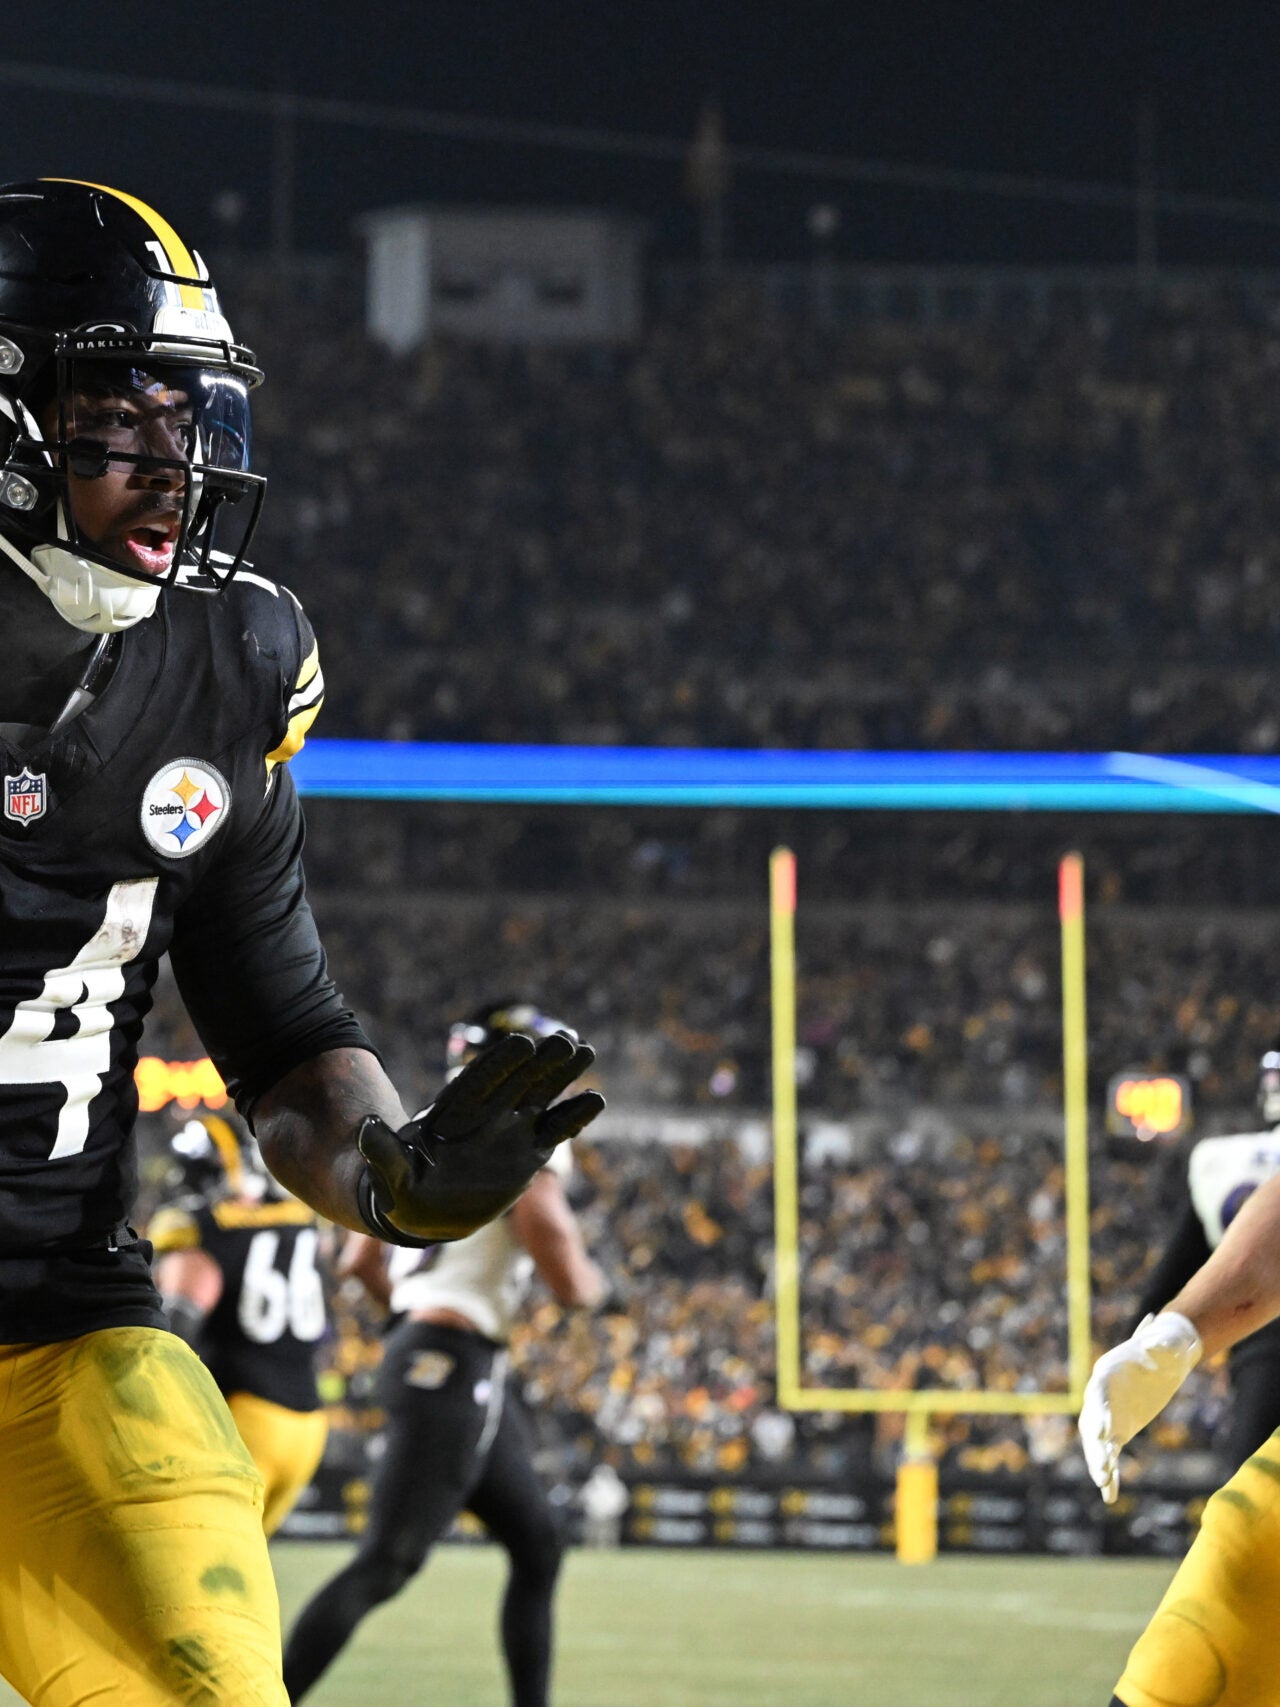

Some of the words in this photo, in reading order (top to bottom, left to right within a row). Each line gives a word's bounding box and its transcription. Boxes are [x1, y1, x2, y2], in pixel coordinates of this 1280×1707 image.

[11, 794, 40, 816] NFL
[149, 804, 184, 817] Steelers
[238, 1230, 326, 1343] 66
